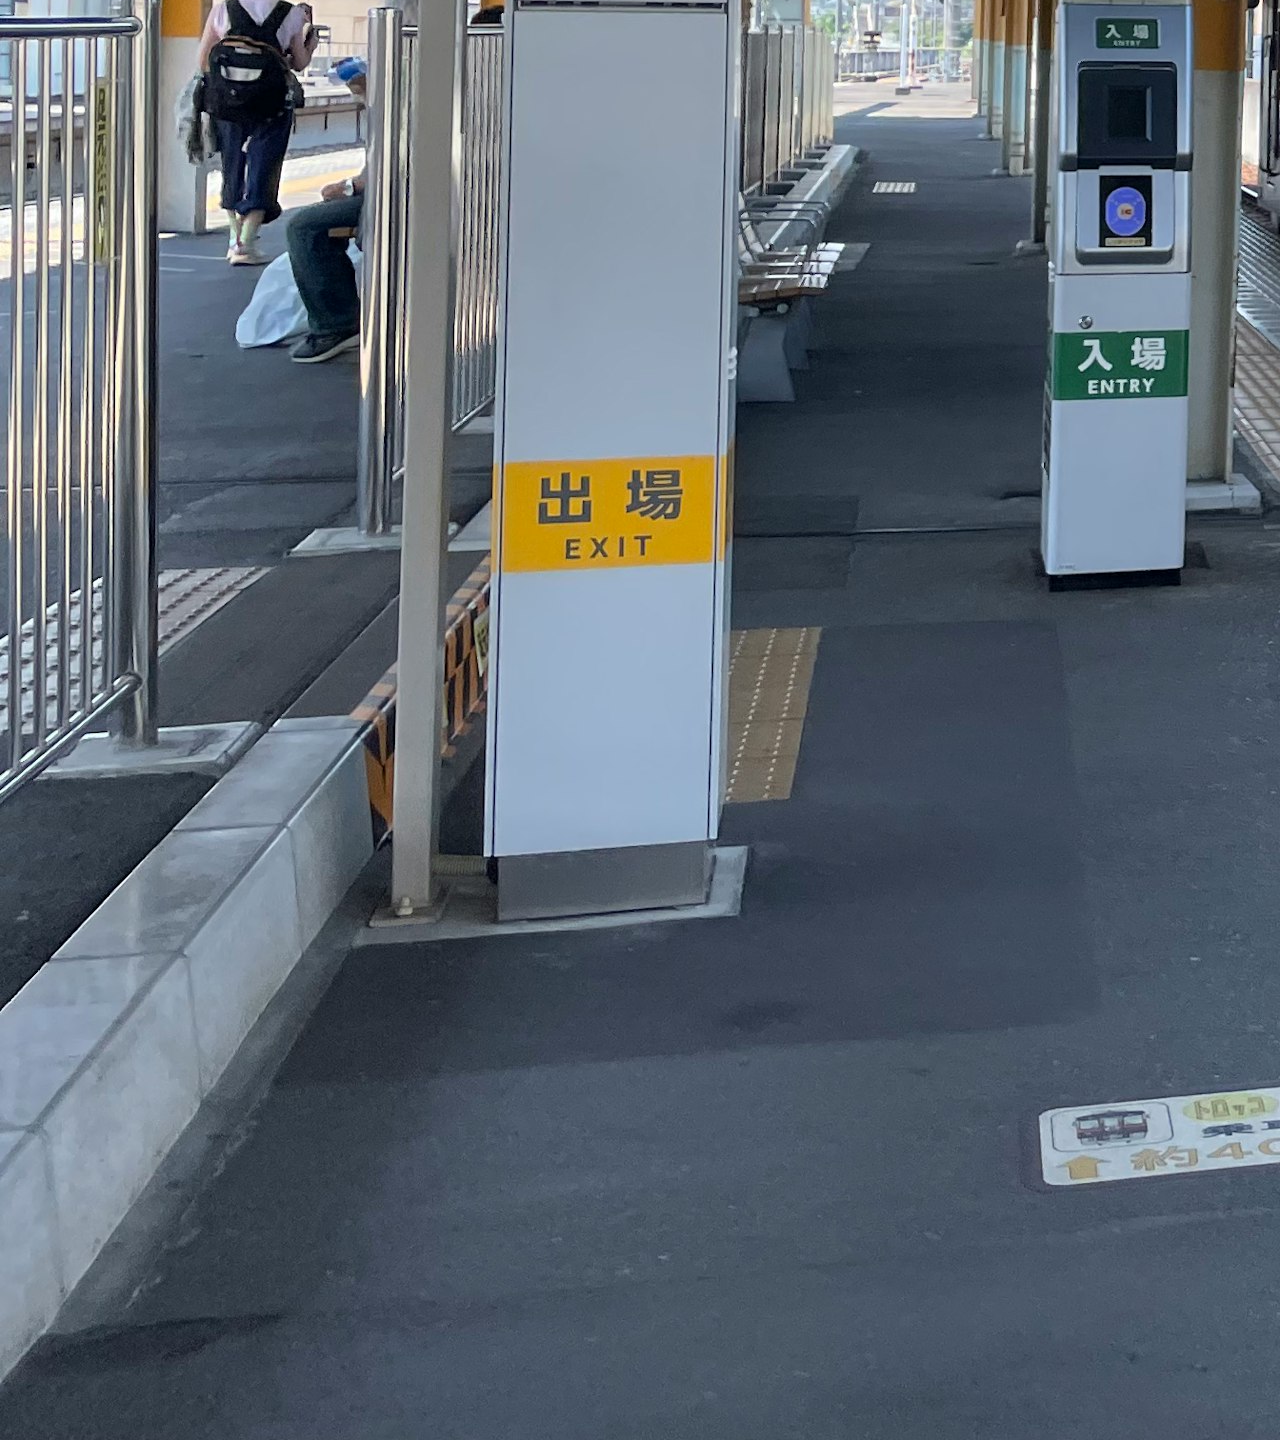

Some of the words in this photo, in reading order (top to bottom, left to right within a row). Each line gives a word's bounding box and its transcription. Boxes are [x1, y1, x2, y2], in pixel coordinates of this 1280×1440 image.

[1105, 24, 1150, 39] 入場
[1077, 336, 1167, 372] 入場
[1088, 378, 1155, 395] ENTRY
[538, 469, 684, 525] 出場
[565, 535, 653, 560] EXIT
